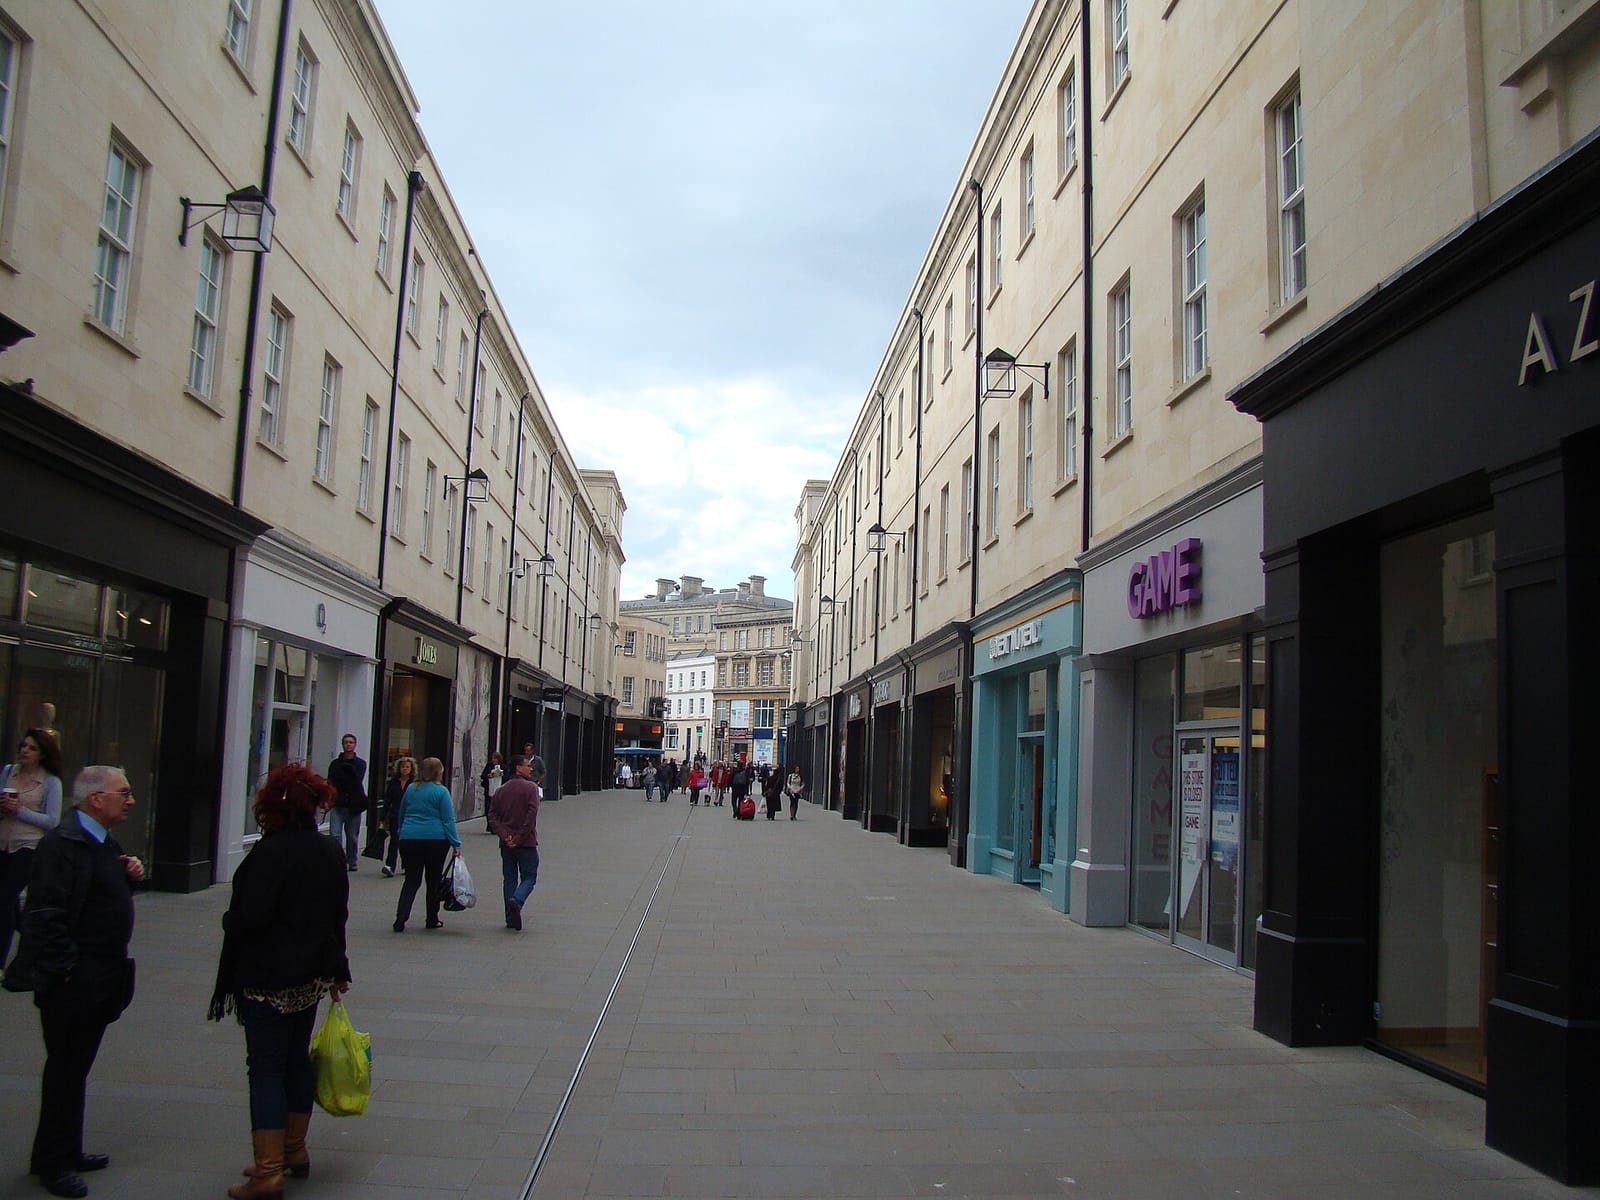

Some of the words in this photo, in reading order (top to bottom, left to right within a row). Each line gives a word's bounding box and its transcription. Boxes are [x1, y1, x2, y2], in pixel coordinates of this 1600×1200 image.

[1127, 538, 1201, 620] GAME
[1183, 770, 1191, 785] THIS
[1192, 770, 1204, 785] STORE
[1150, 735, 1172, 860] GAME
[1188, 787, 1202, 802] CLOSED
[1185, 815, 1199, 829] GAME
